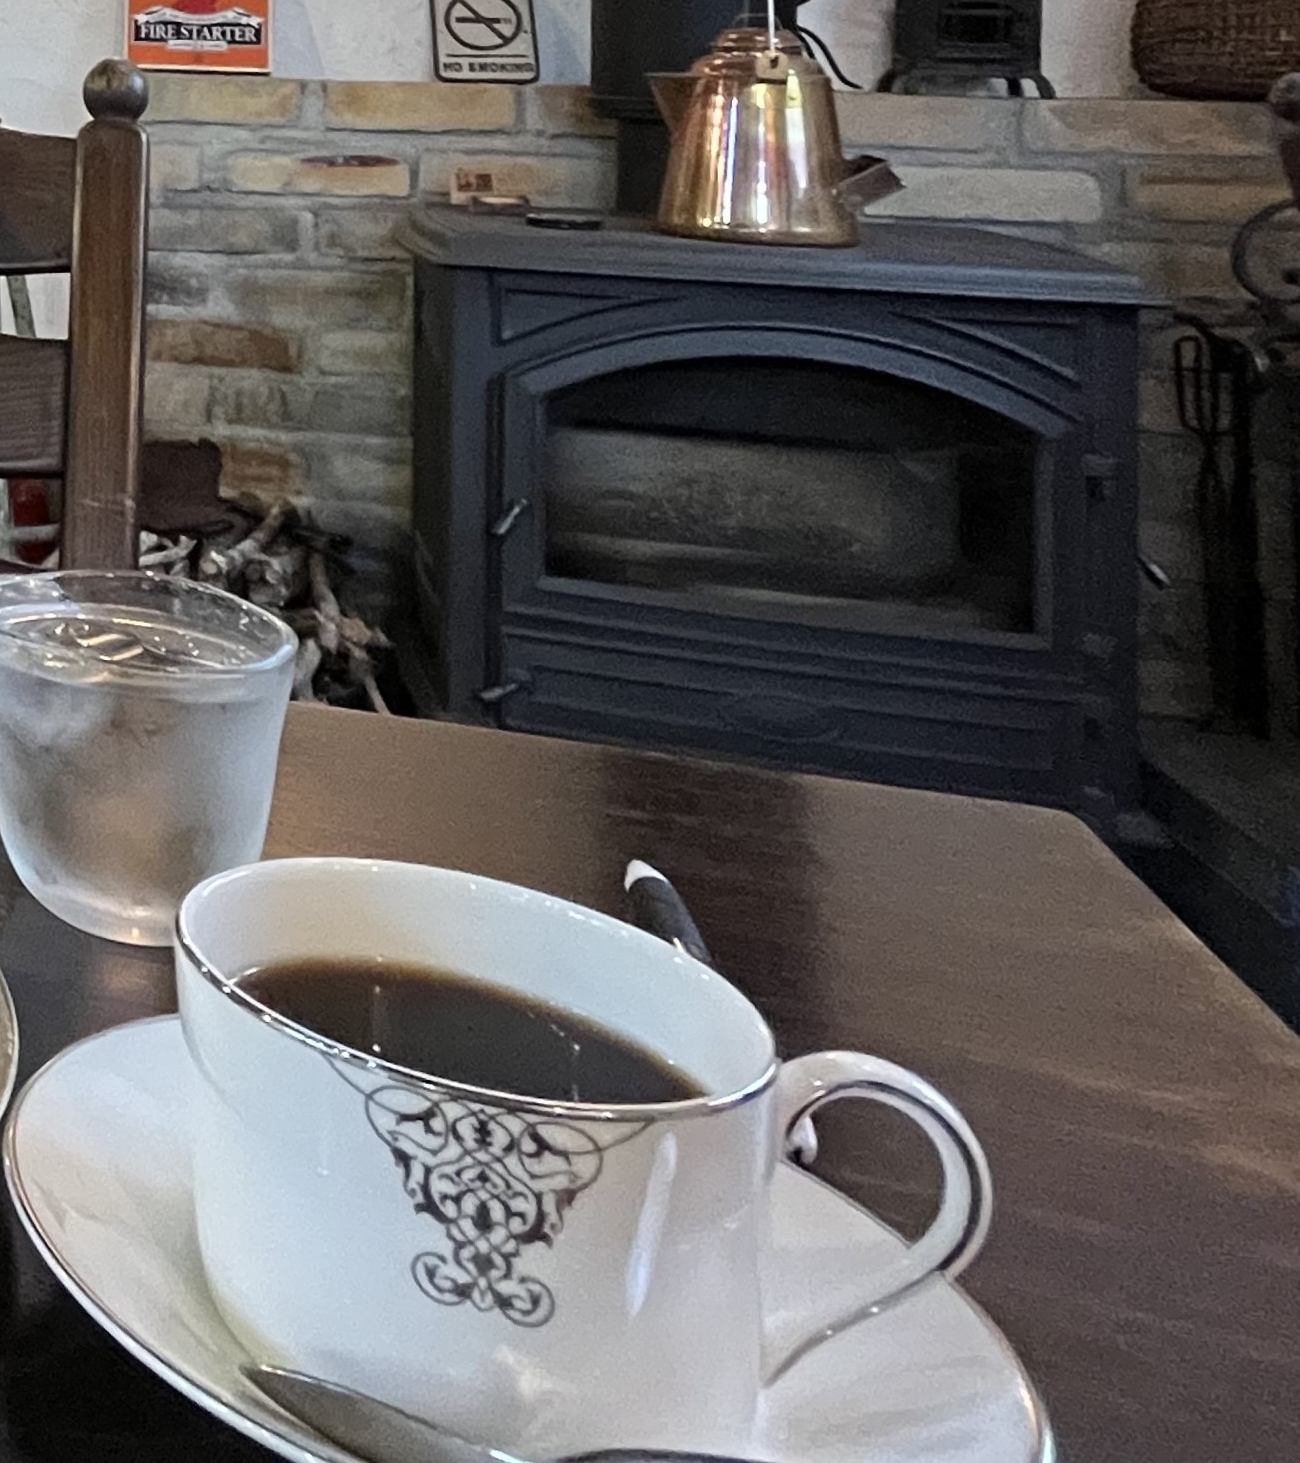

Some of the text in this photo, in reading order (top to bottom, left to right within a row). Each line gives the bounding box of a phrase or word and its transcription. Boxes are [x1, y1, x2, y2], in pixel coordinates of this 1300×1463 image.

[140, 23, 257, 42] FIRE STARTER
[442, 62, 536, 73] NO SMOKING
